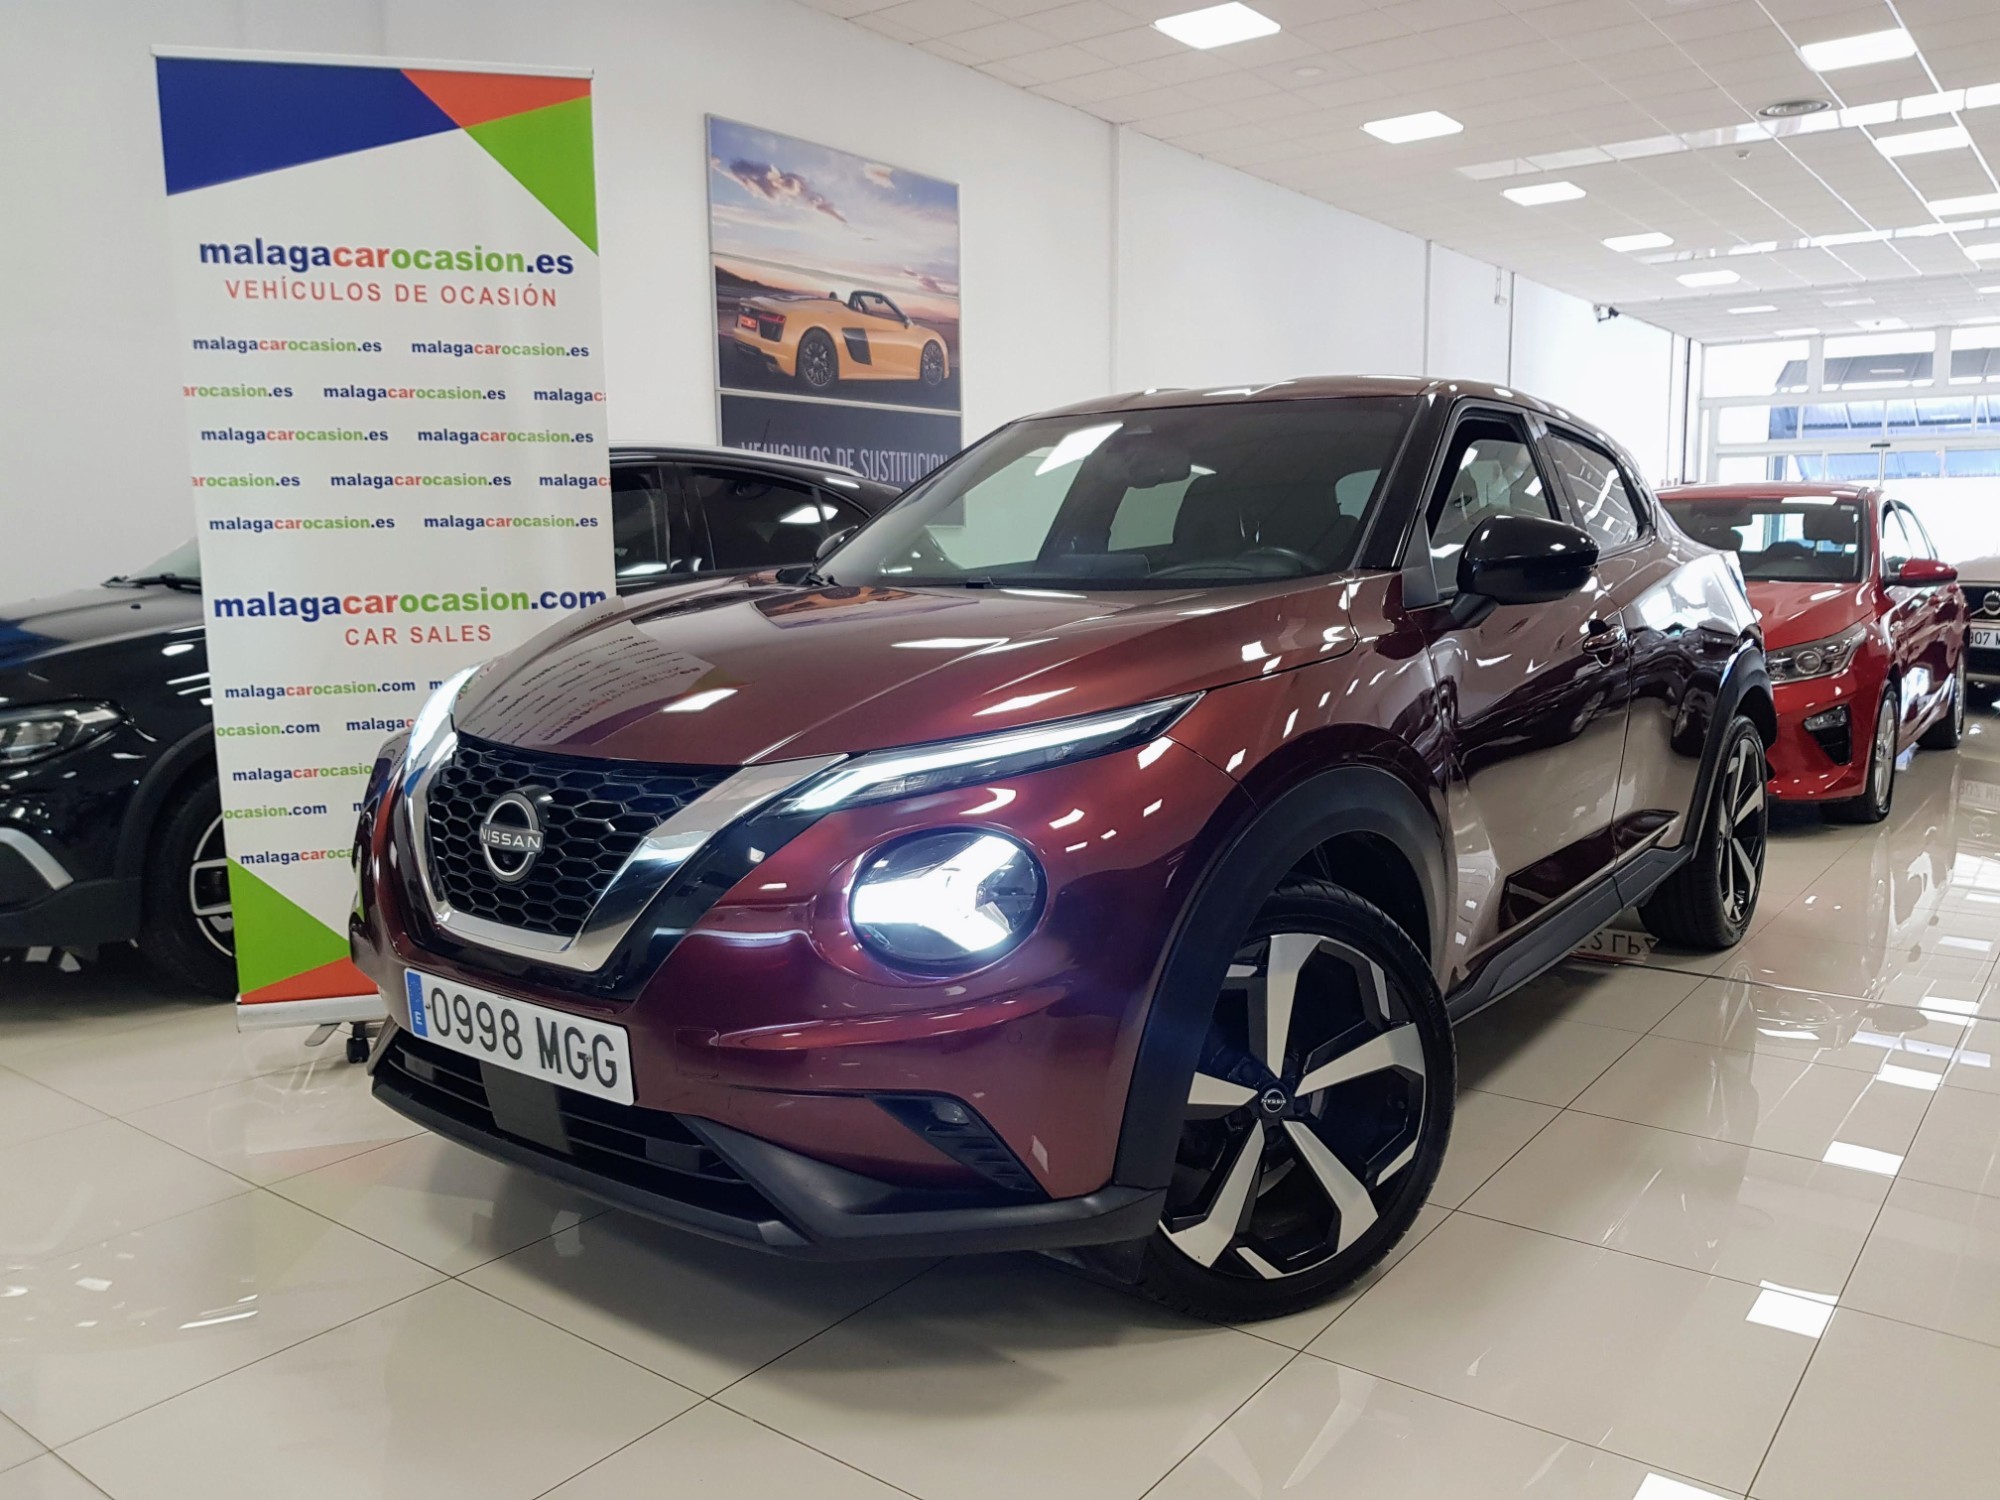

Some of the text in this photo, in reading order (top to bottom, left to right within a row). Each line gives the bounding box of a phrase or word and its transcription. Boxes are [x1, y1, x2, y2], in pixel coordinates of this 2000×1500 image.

[199, 238, 574, 274] malagacarocasion.es
[226, 276, 555, 306] VEHÍCULOS DE OCASIÓN
[193, 337, 382, 353] malagacarocasion.es
[412, 340, 589, 357] malagacarocasion.es
[324, 385, 506, 401] malagacarocasion.es
[534, 388, 606, 404] malagac
[201, 428, 388, 444] malagacarocasion.es
[418, 428, 593, 445] malagacarocasion.es
[860, 448, 948, 482] SUSTITUCIO
[331, 473, 511, 489] malagacarocasion.es
[540, 474, 610, 489] malagac
[210, 516, 395, 532] malagacarocasion.es
[424, 515, 598, 530] malagacarocasion.es
[214, 587, 607, 622] malagacarocasion.com
[346, 625, 490, 645] CAR SALES
[225, 681, 415, 700] malagacarocasion.com
[217, 723, 320, 736] ocasion.com
[224, 805, 327, 819] ocasion.com
[481, 827, 540, 848] NISSAN
[415, 987, 617, 1088] E 0998 MGG
